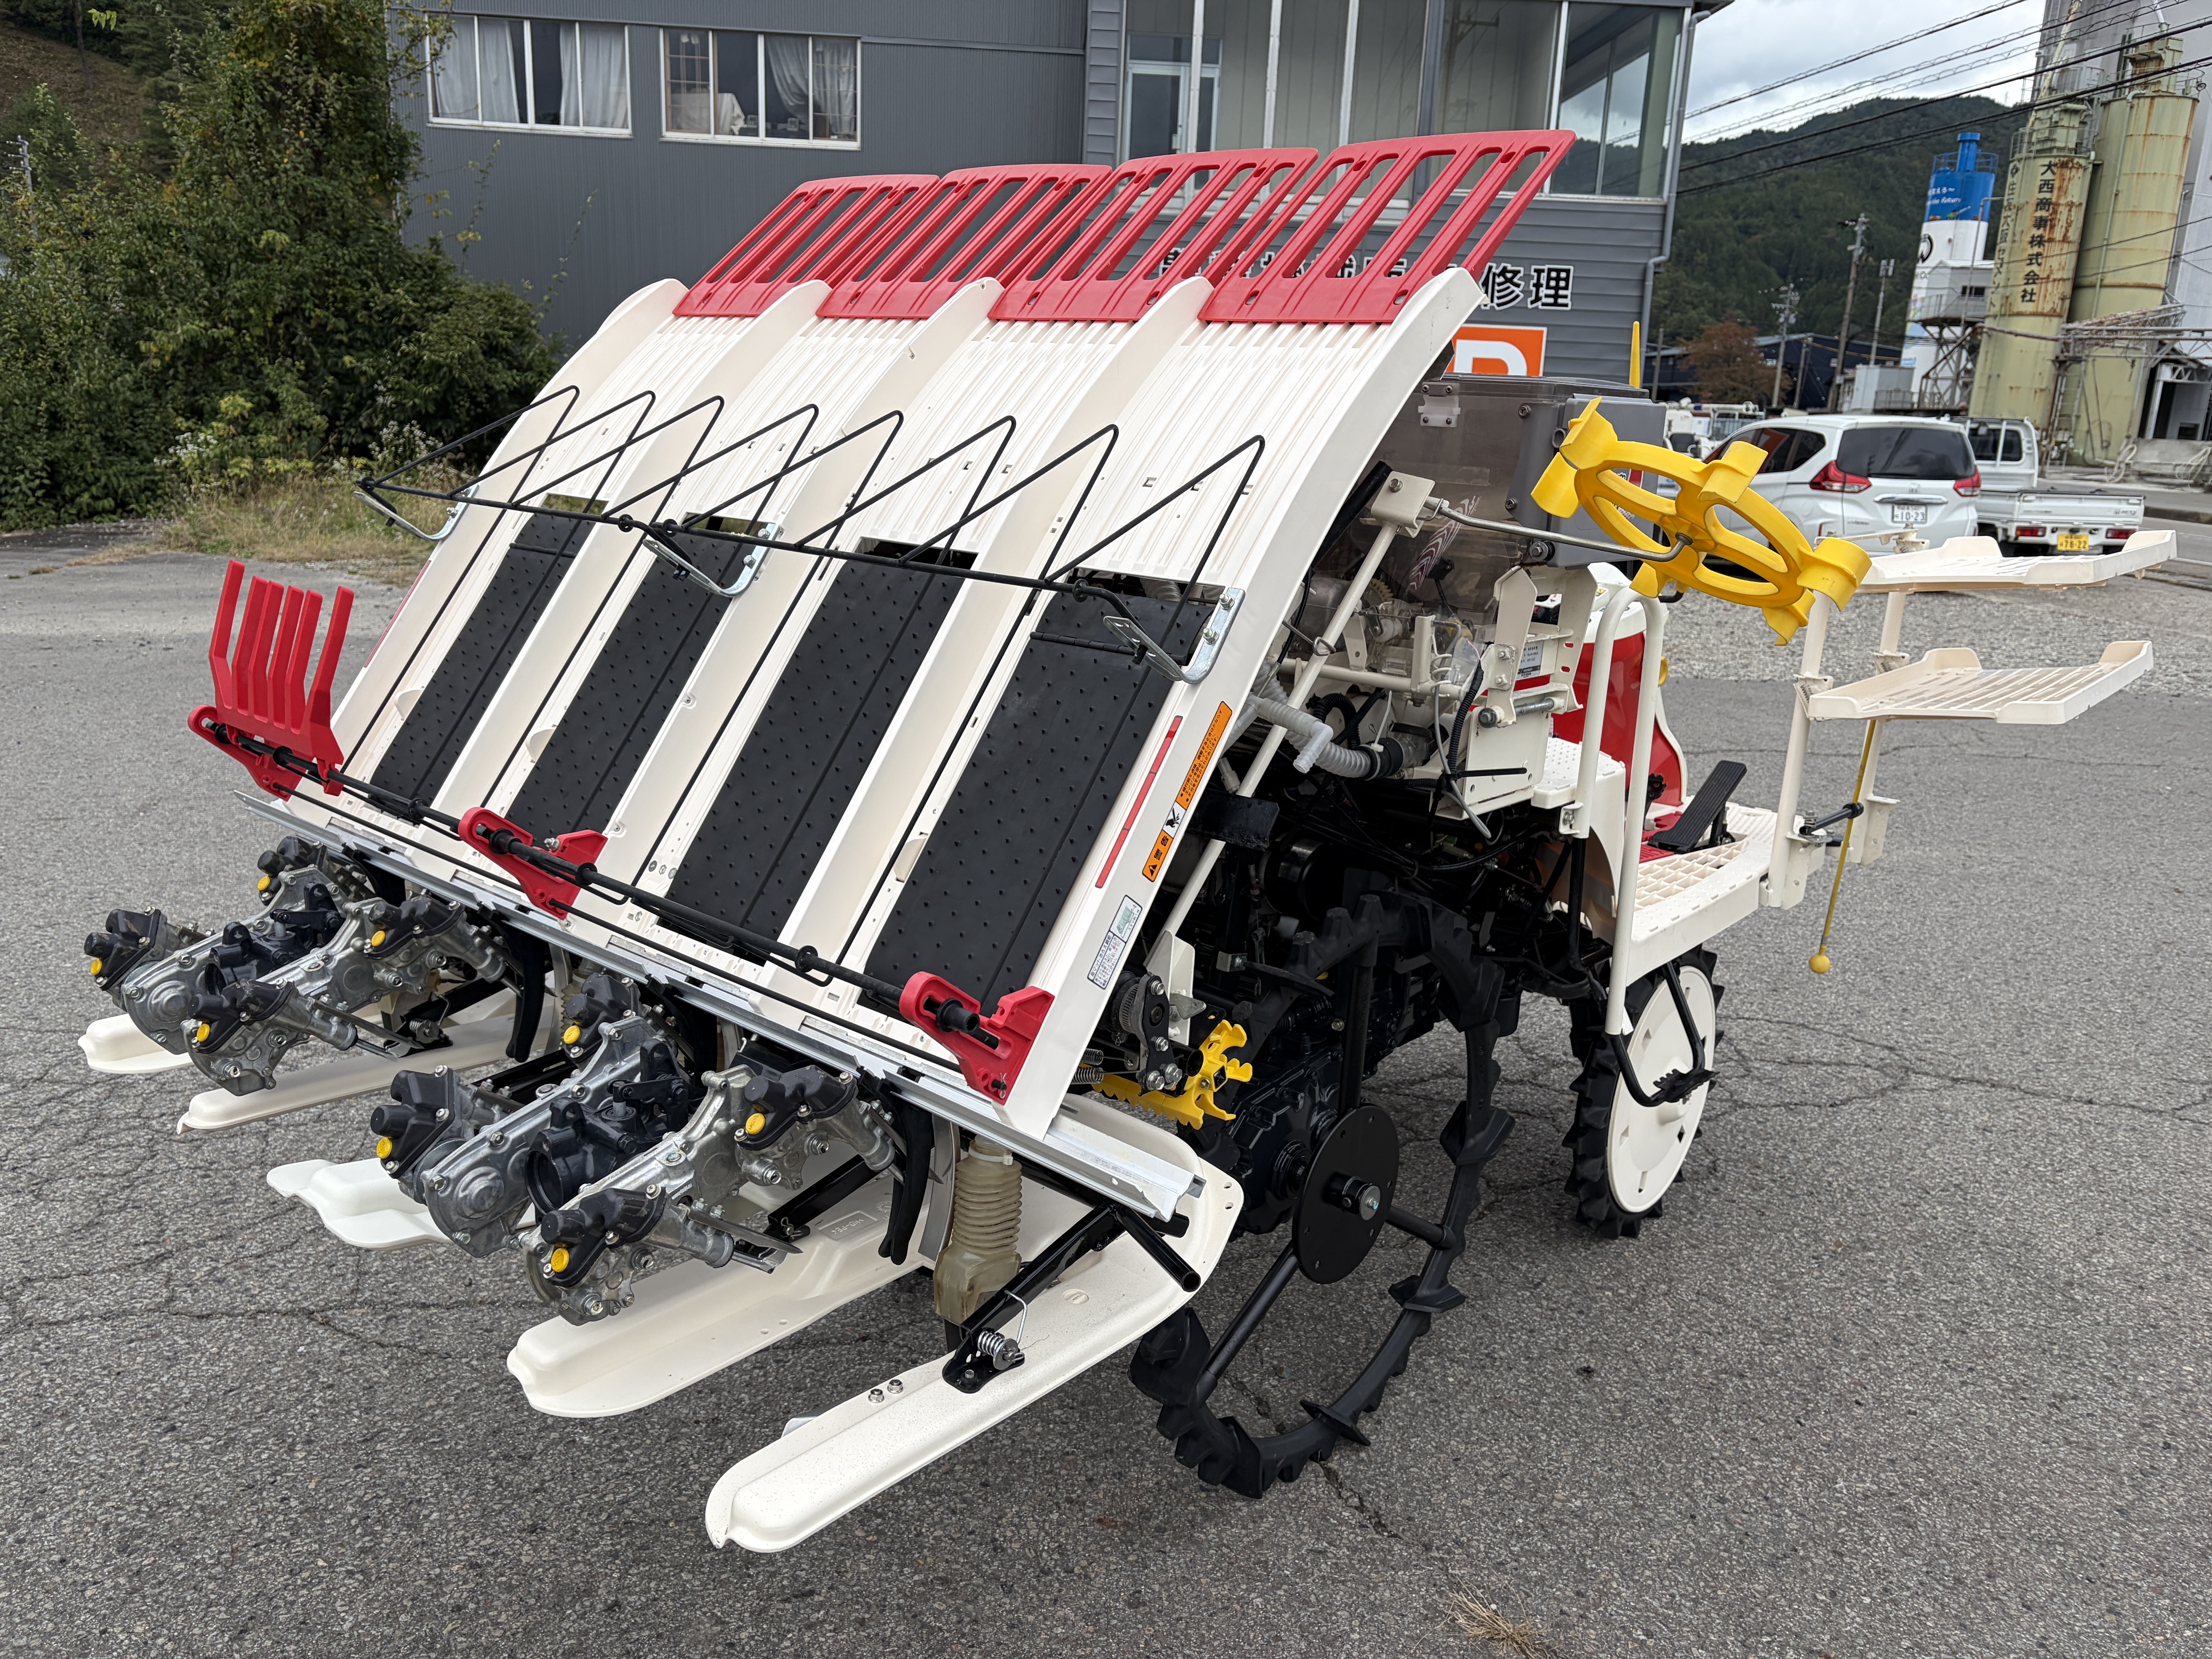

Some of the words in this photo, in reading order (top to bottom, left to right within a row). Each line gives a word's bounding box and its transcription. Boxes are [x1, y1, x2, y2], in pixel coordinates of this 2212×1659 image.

[2021, 161, 2056, 303] 大西商事株式会社
[1154, 835, 1169, 860] 警告
